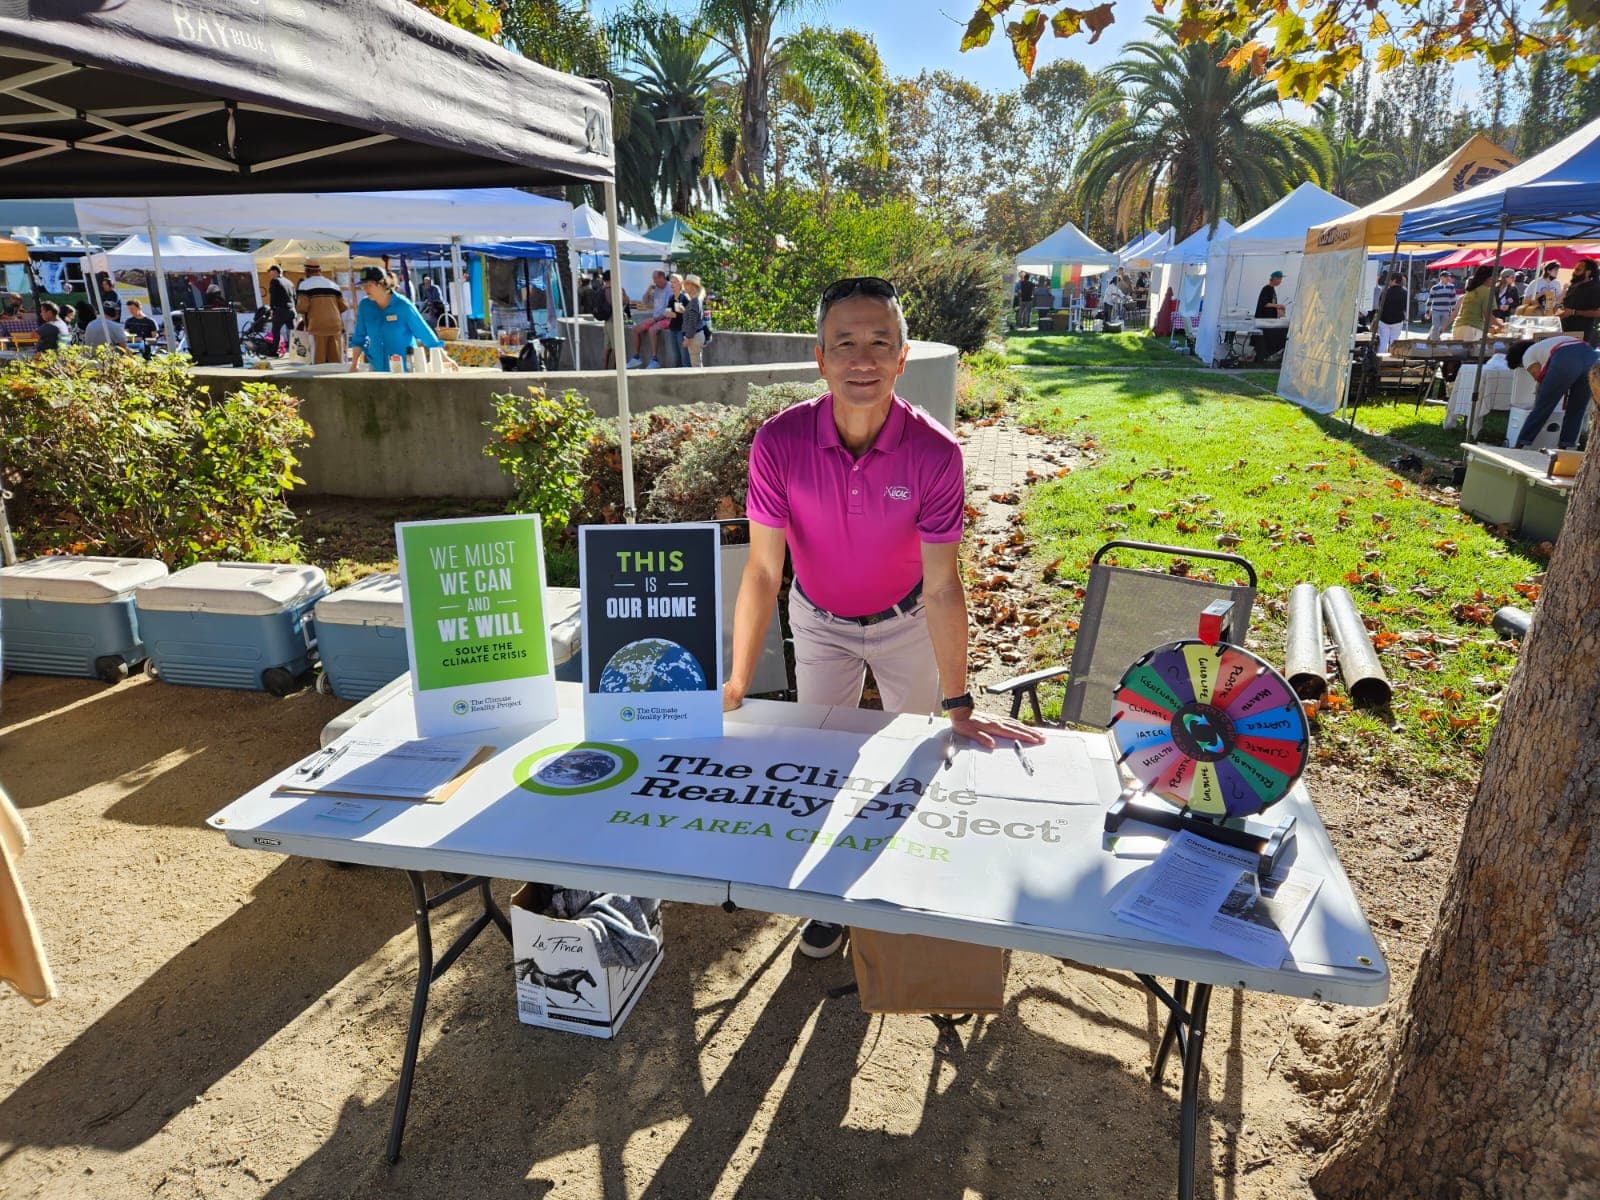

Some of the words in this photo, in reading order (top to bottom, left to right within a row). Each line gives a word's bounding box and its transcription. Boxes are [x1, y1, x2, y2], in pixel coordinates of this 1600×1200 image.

[172, 4, 230, 48] BAY
[429, 545, 459, 570] WE
[464, 541, 516, 567] MUST
[616, 551, 684, 572] THIS
[440, 571, 470, 595] WE
[474, 568, 512, 593] CAN
[645, 577, 657, 592] IS
[467, 597, 491, 612] AND
[606, 597, 642, 618] OUR
[647, 596, 697, 617] HOME
[437, 617, 470, 642] WE
[474, 612, 523, 638] WILL
[442, 654, 490, 667] CLIMATE
[492, 650, 527, 660] CRISIS
[455, 644, 490, 656] SOLVE
[493, 642, 513, 651] THE
[662, 713, 688, 721] Project
[1129, 703, 1168, 721] CLIMATE
[657, 754, 753, 779] The
[765, 763, 979, 806] Climate
[630, 776, 834, 817] Reality
[844, 796, 1062, 844] Project
[606, 810, 681, 828] BAY
[681, 817, 774, 838] AREA
[785, 828, 951, 862] CHAPTER
[532, 934, 545, 950] La
[547, 936, 584, 954] Finca
